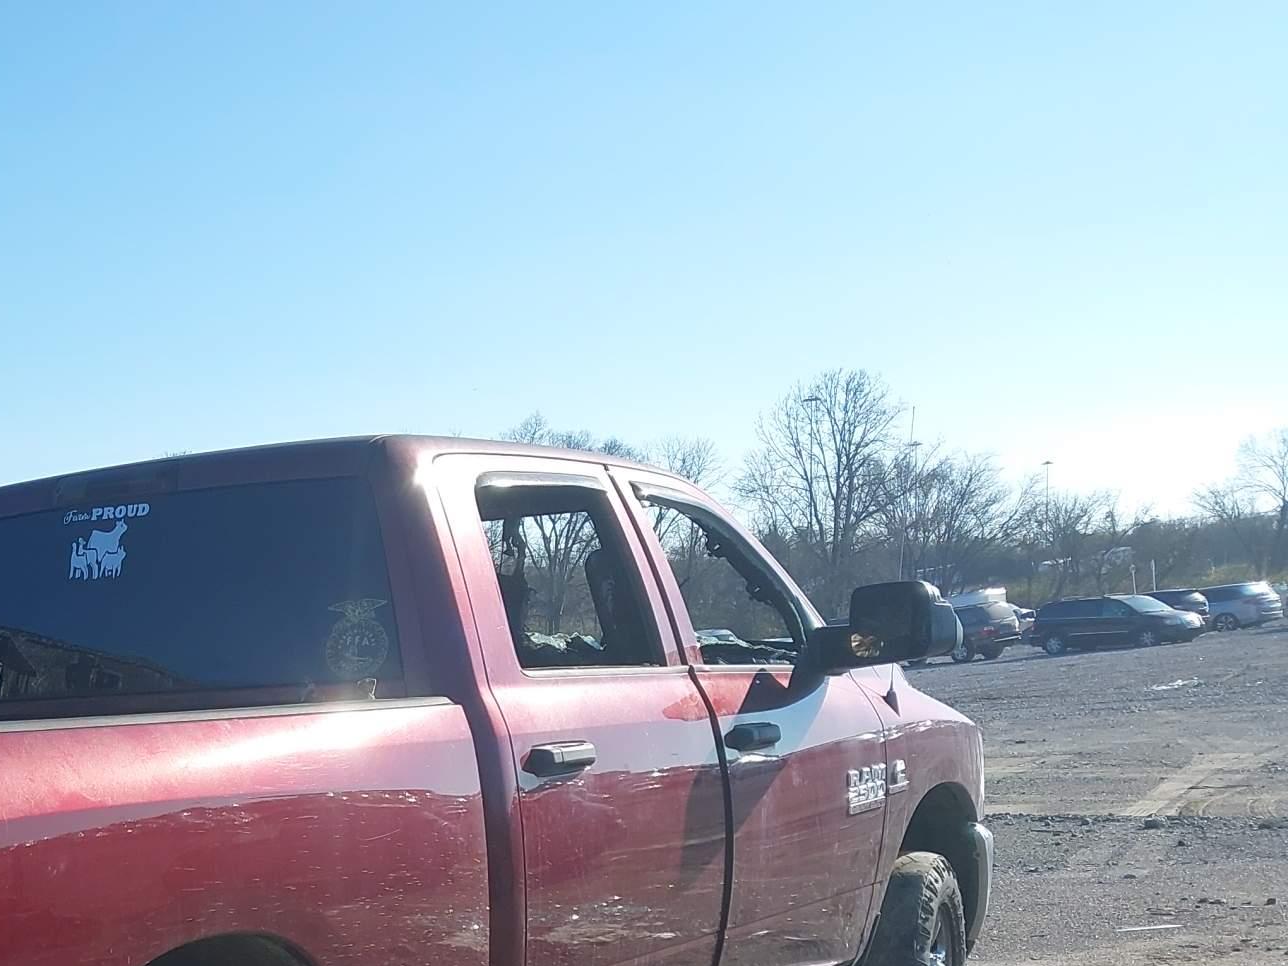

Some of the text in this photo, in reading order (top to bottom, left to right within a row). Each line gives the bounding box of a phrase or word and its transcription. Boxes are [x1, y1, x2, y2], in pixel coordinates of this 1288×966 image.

[90, 503, 150, 521] PROUD
[847, 763, 887, 787] RAM
[848, 780, 887, 803] 2500
